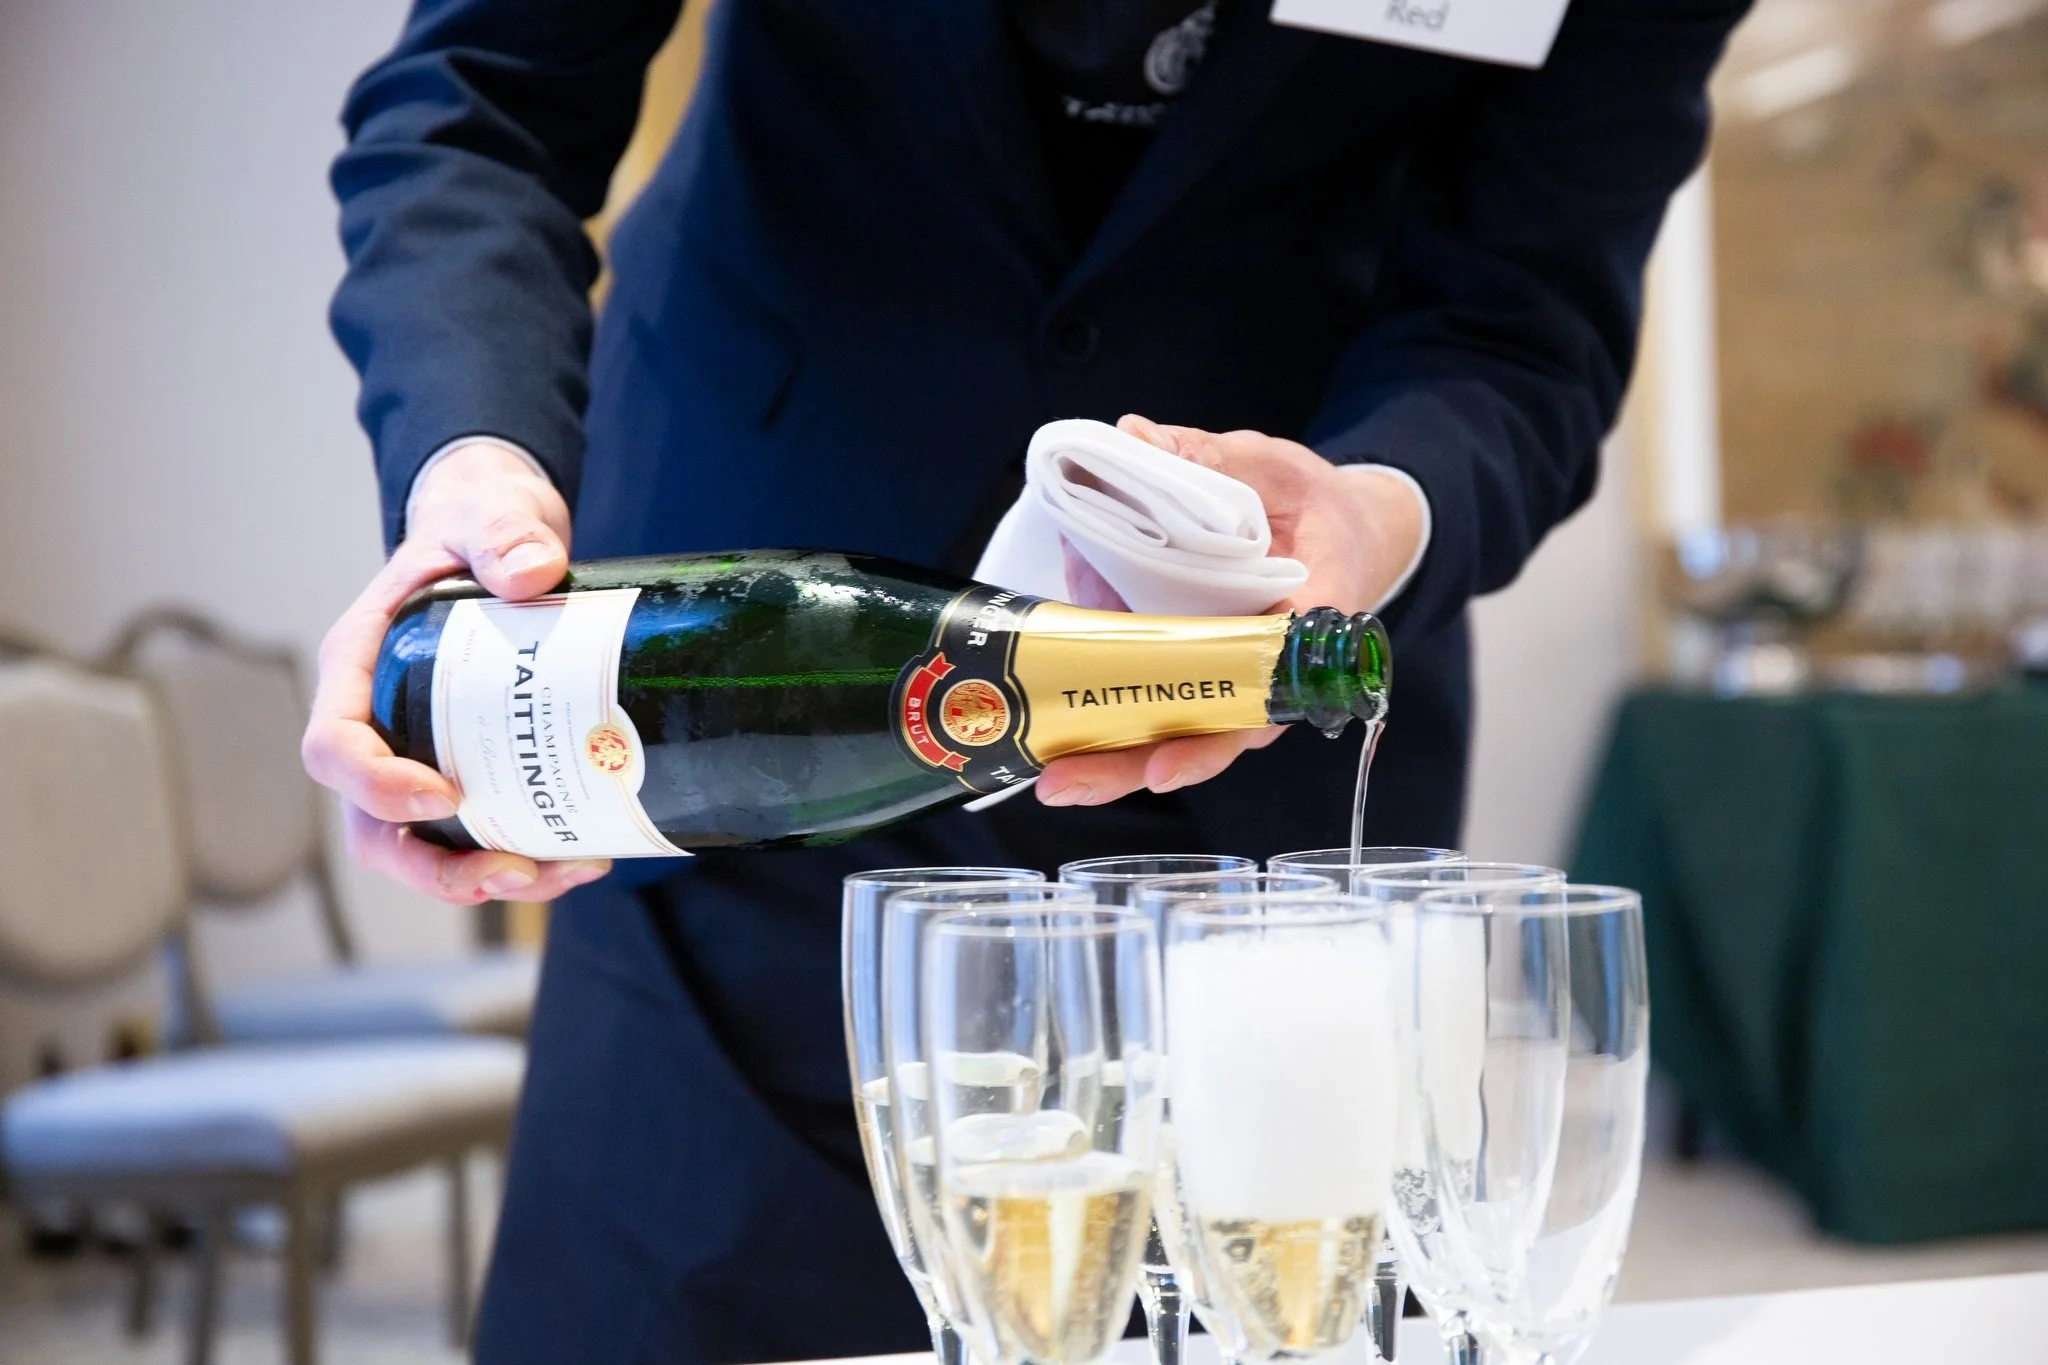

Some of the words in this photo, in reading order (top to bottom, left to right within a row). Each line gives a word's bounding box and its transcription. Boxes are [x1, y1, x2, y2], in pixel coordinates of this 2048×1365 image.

[908, 697, 930, 745] BRUT
[1061, 680, 1237, 709] TAITTINGER
[514, 640, 579, 843] TAITTINGER
[540, 685, 579, 814] CHAMPAGNE
